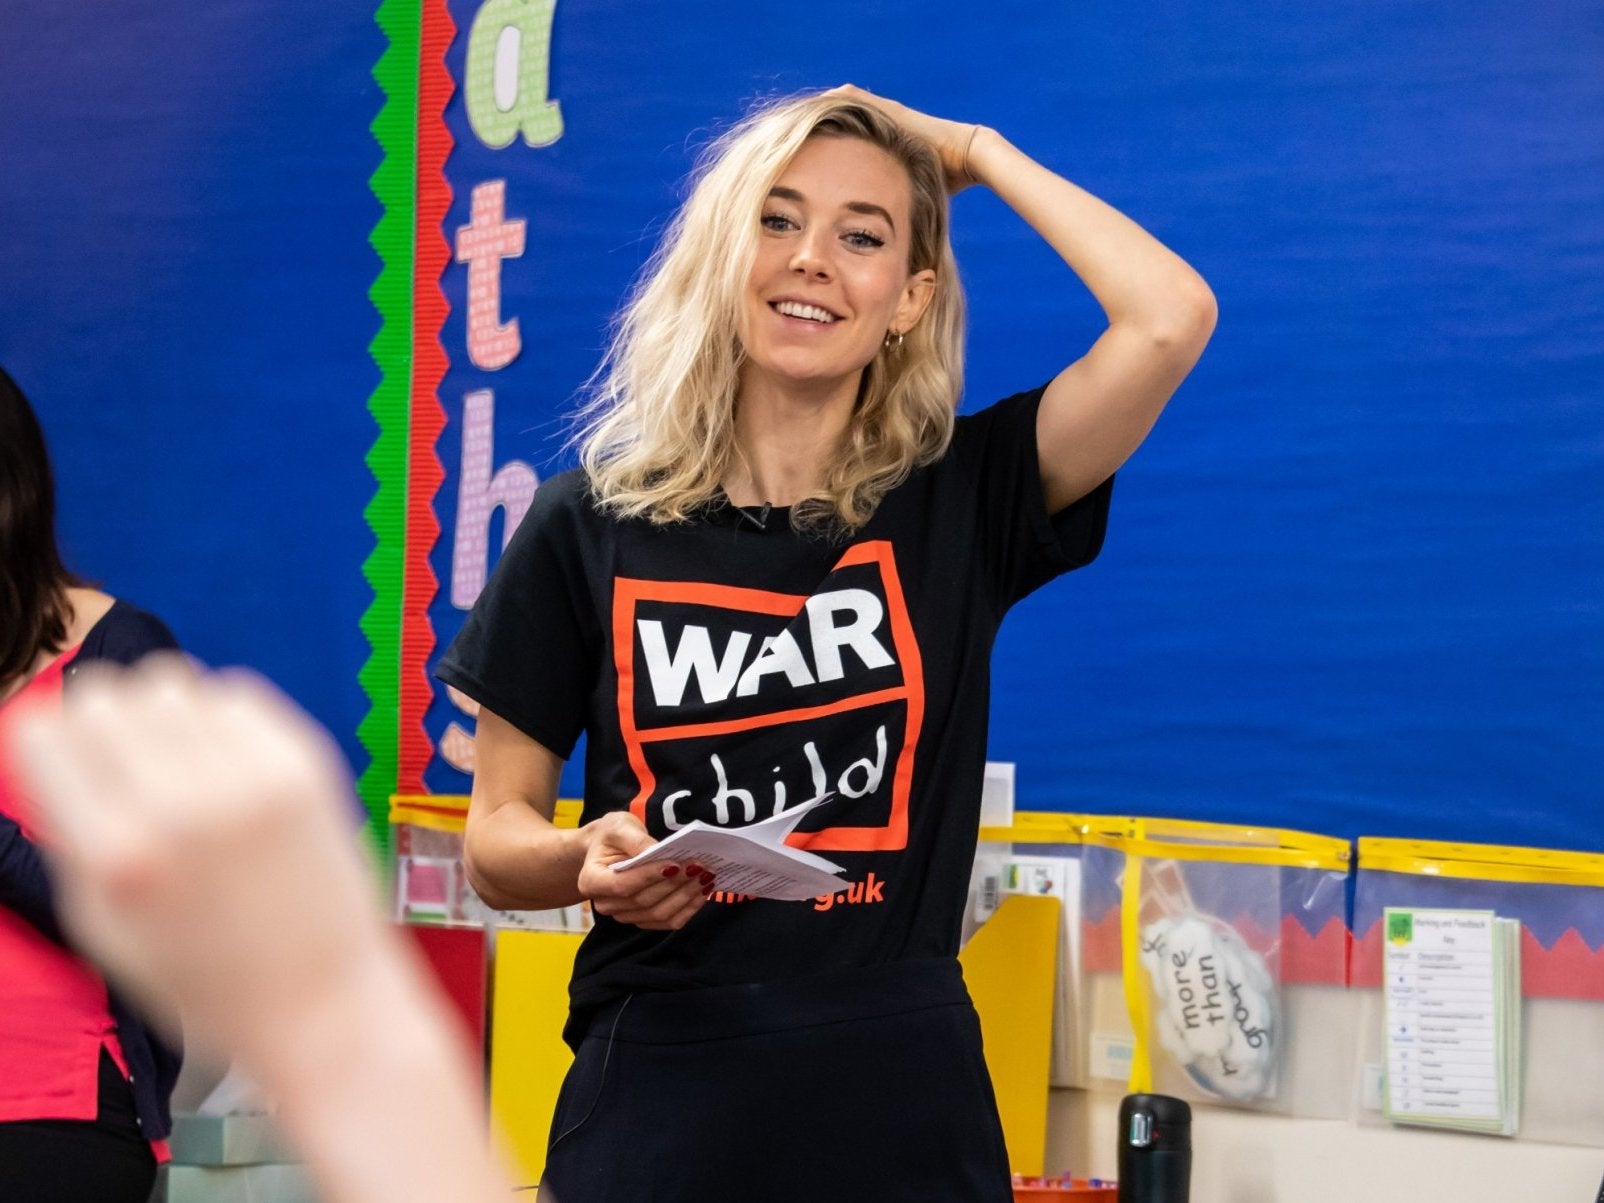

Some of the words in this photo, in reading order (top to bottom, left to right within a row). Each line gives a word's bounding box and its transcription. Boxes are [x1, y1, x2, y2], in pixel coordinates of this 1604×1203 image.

[636, 588, 896, 707] WAR
[662, 725, 888, 831] child
[1173, 950, 1200, 1029] more
[1199, 955, 1224, 1026] than
